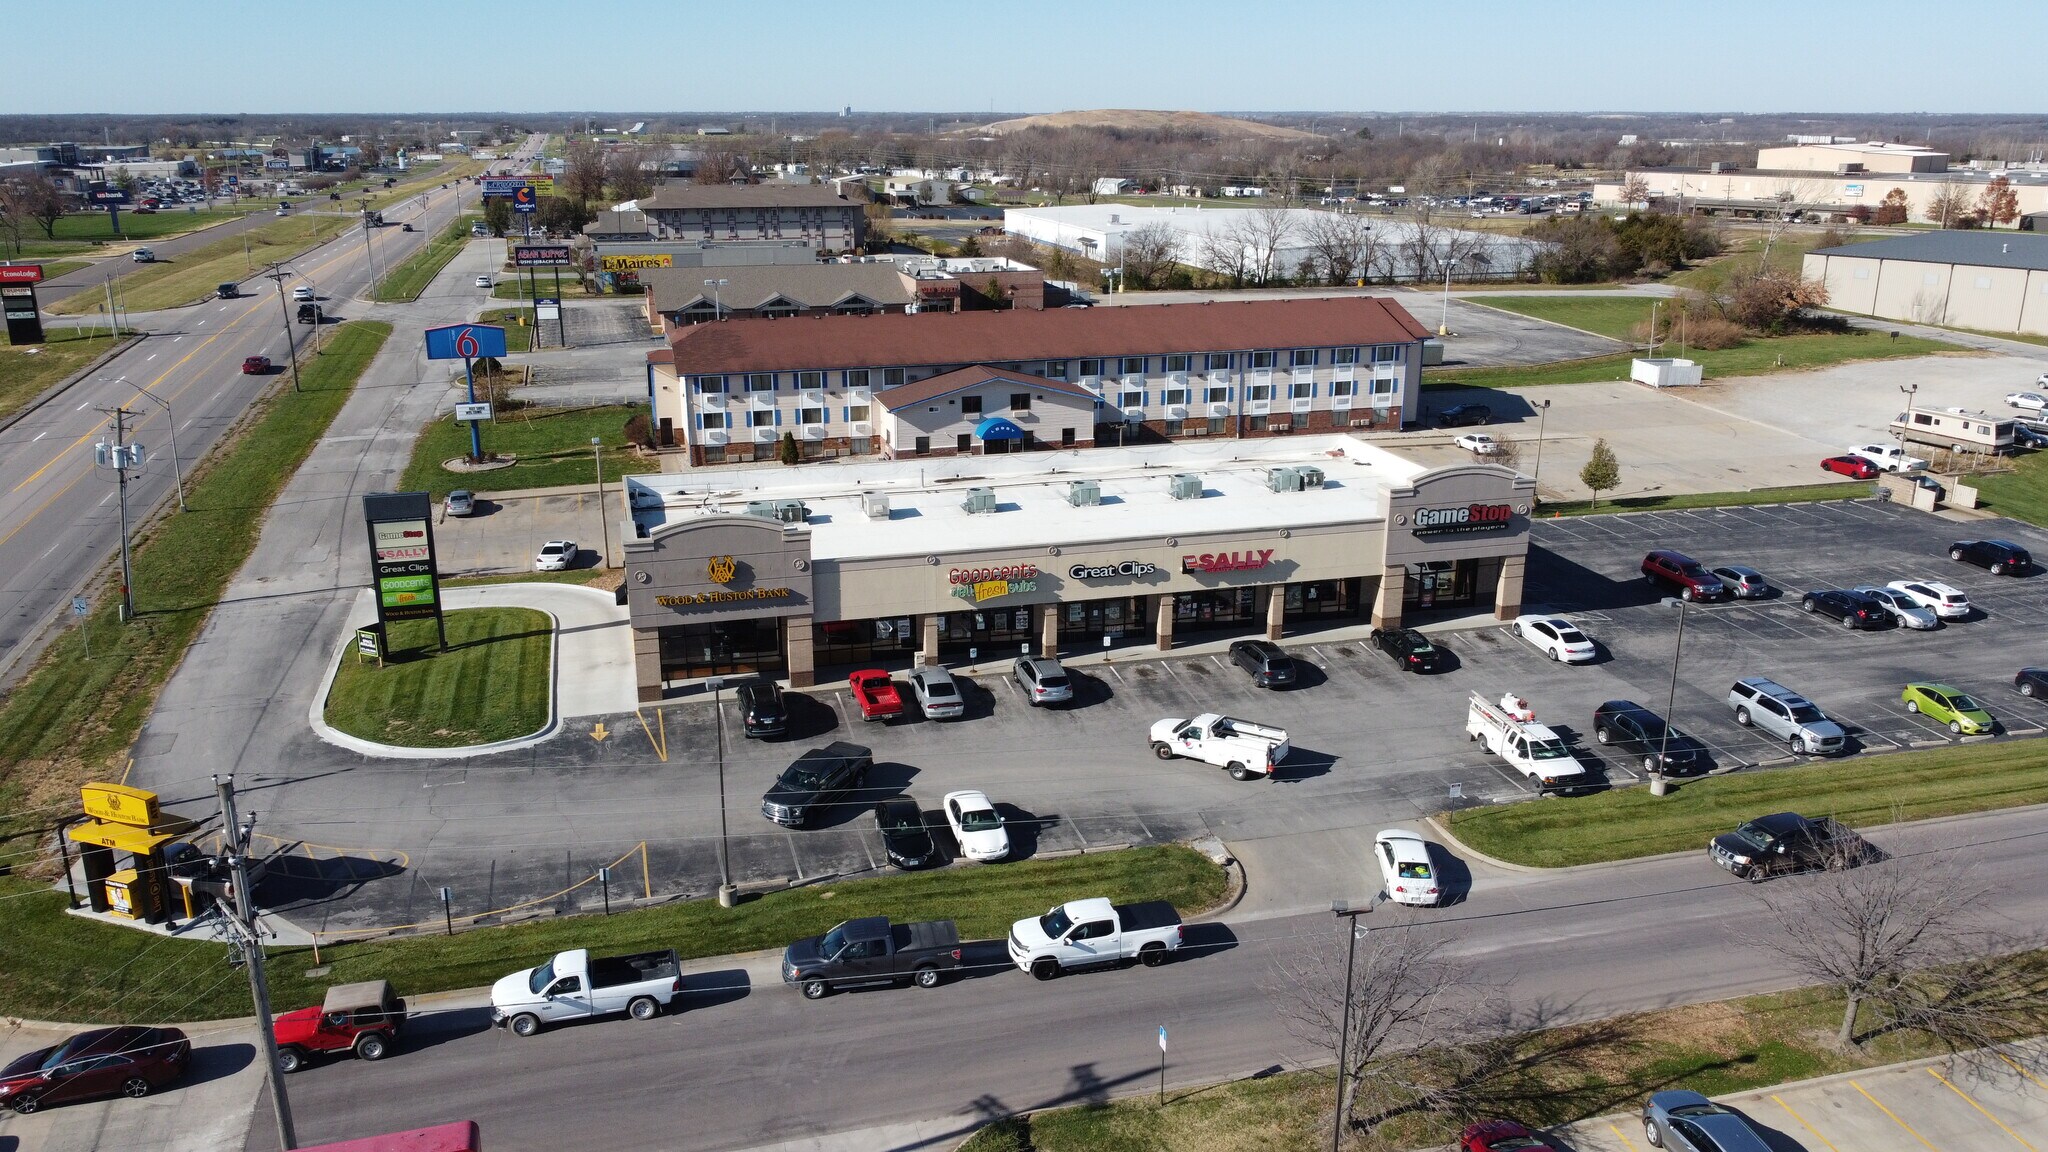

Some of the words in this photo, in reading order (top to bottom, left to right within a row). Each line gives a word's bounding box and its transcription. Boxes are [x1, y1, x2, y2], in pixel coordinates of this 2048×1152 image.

[518, 250, 538, 258] ASIAN
[456, 327, 479, 357] 6
[990, 426, 1015, 434] LOBBY
[1414, 503, 1512, 526] GameStop
[1472, 524, 1506, 532] players
[379, 531, 424, 540] GameStop
[386, 548, 428, 558] SALLY
[1198, 549, 1274, 569] SALLY
[408, 564, 429, 572] Clips
[1069, 565, 1115, 579] Great
[1118, 561, 1155, 578] Clips
[950, 584, 975, 598] deli
[976, 582, 1006, 600] fresh
[1008, 580, 1037, 593] subs
[384, 595, 396, 603] deli
[398, 593, 416, 603] fresh
[695, 593, 706, 604] &
[709, 590, 754, 603] HUSTON
[757, 587, 790, 599] BANK
[101, 838, 116, 847] ATM
